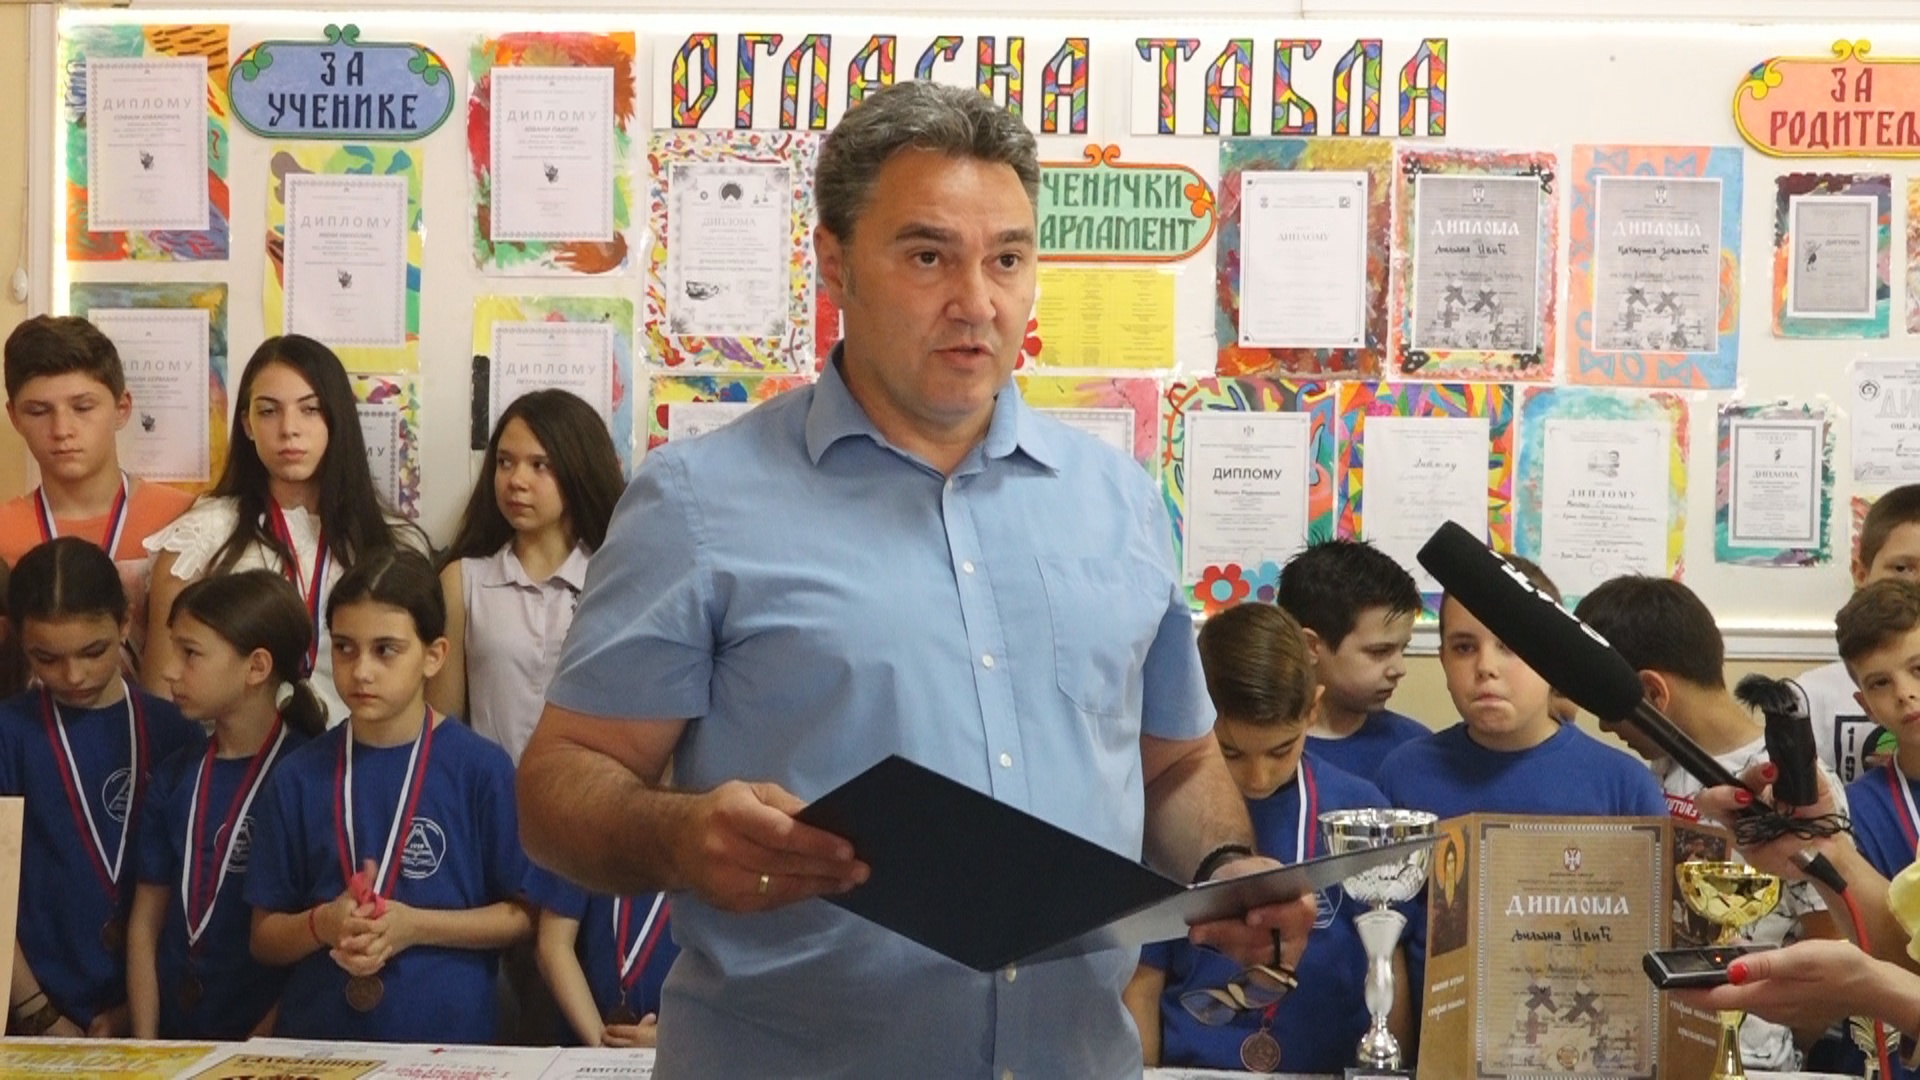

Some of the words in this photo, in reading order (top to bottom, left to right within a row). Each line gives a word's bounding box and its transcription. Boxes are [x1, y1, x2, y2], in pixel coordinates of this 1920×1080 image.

[320, 51, 364, 87] ЗА
[1135, 38, 1448, 136] ТАБЛА
[1830, 67, 1873, 103] ЗА
[103, 97, 192, 111] ДИПЛОМУ
[268, 92, 419, 130] УЧЕНИКЕ
[507, 109, 597, 123] ДИПЛОМУ
[1041, 172, 1182, 209] ЧЕНИЧКИ
[300, 215, 391, 229] ДИПЛОМУ
[701, 217, 756, 227] ДИПЛОМА
[1431, 219, 1520, 236] ДИПЛОМА
[1612, 221, 1702, 237] ДИПЛОМА
[1040, 214, 1197, 251] АРЛАМЕНТ
[121, 360, 192, 371] ИПЛОМУ
[505, 363, 596, 376] ДИПЛОМУ
[1212, 467, 1282, 481] ДИПЛОМУ
[1505, 895, 1630, 917] ДИПЛОМА
